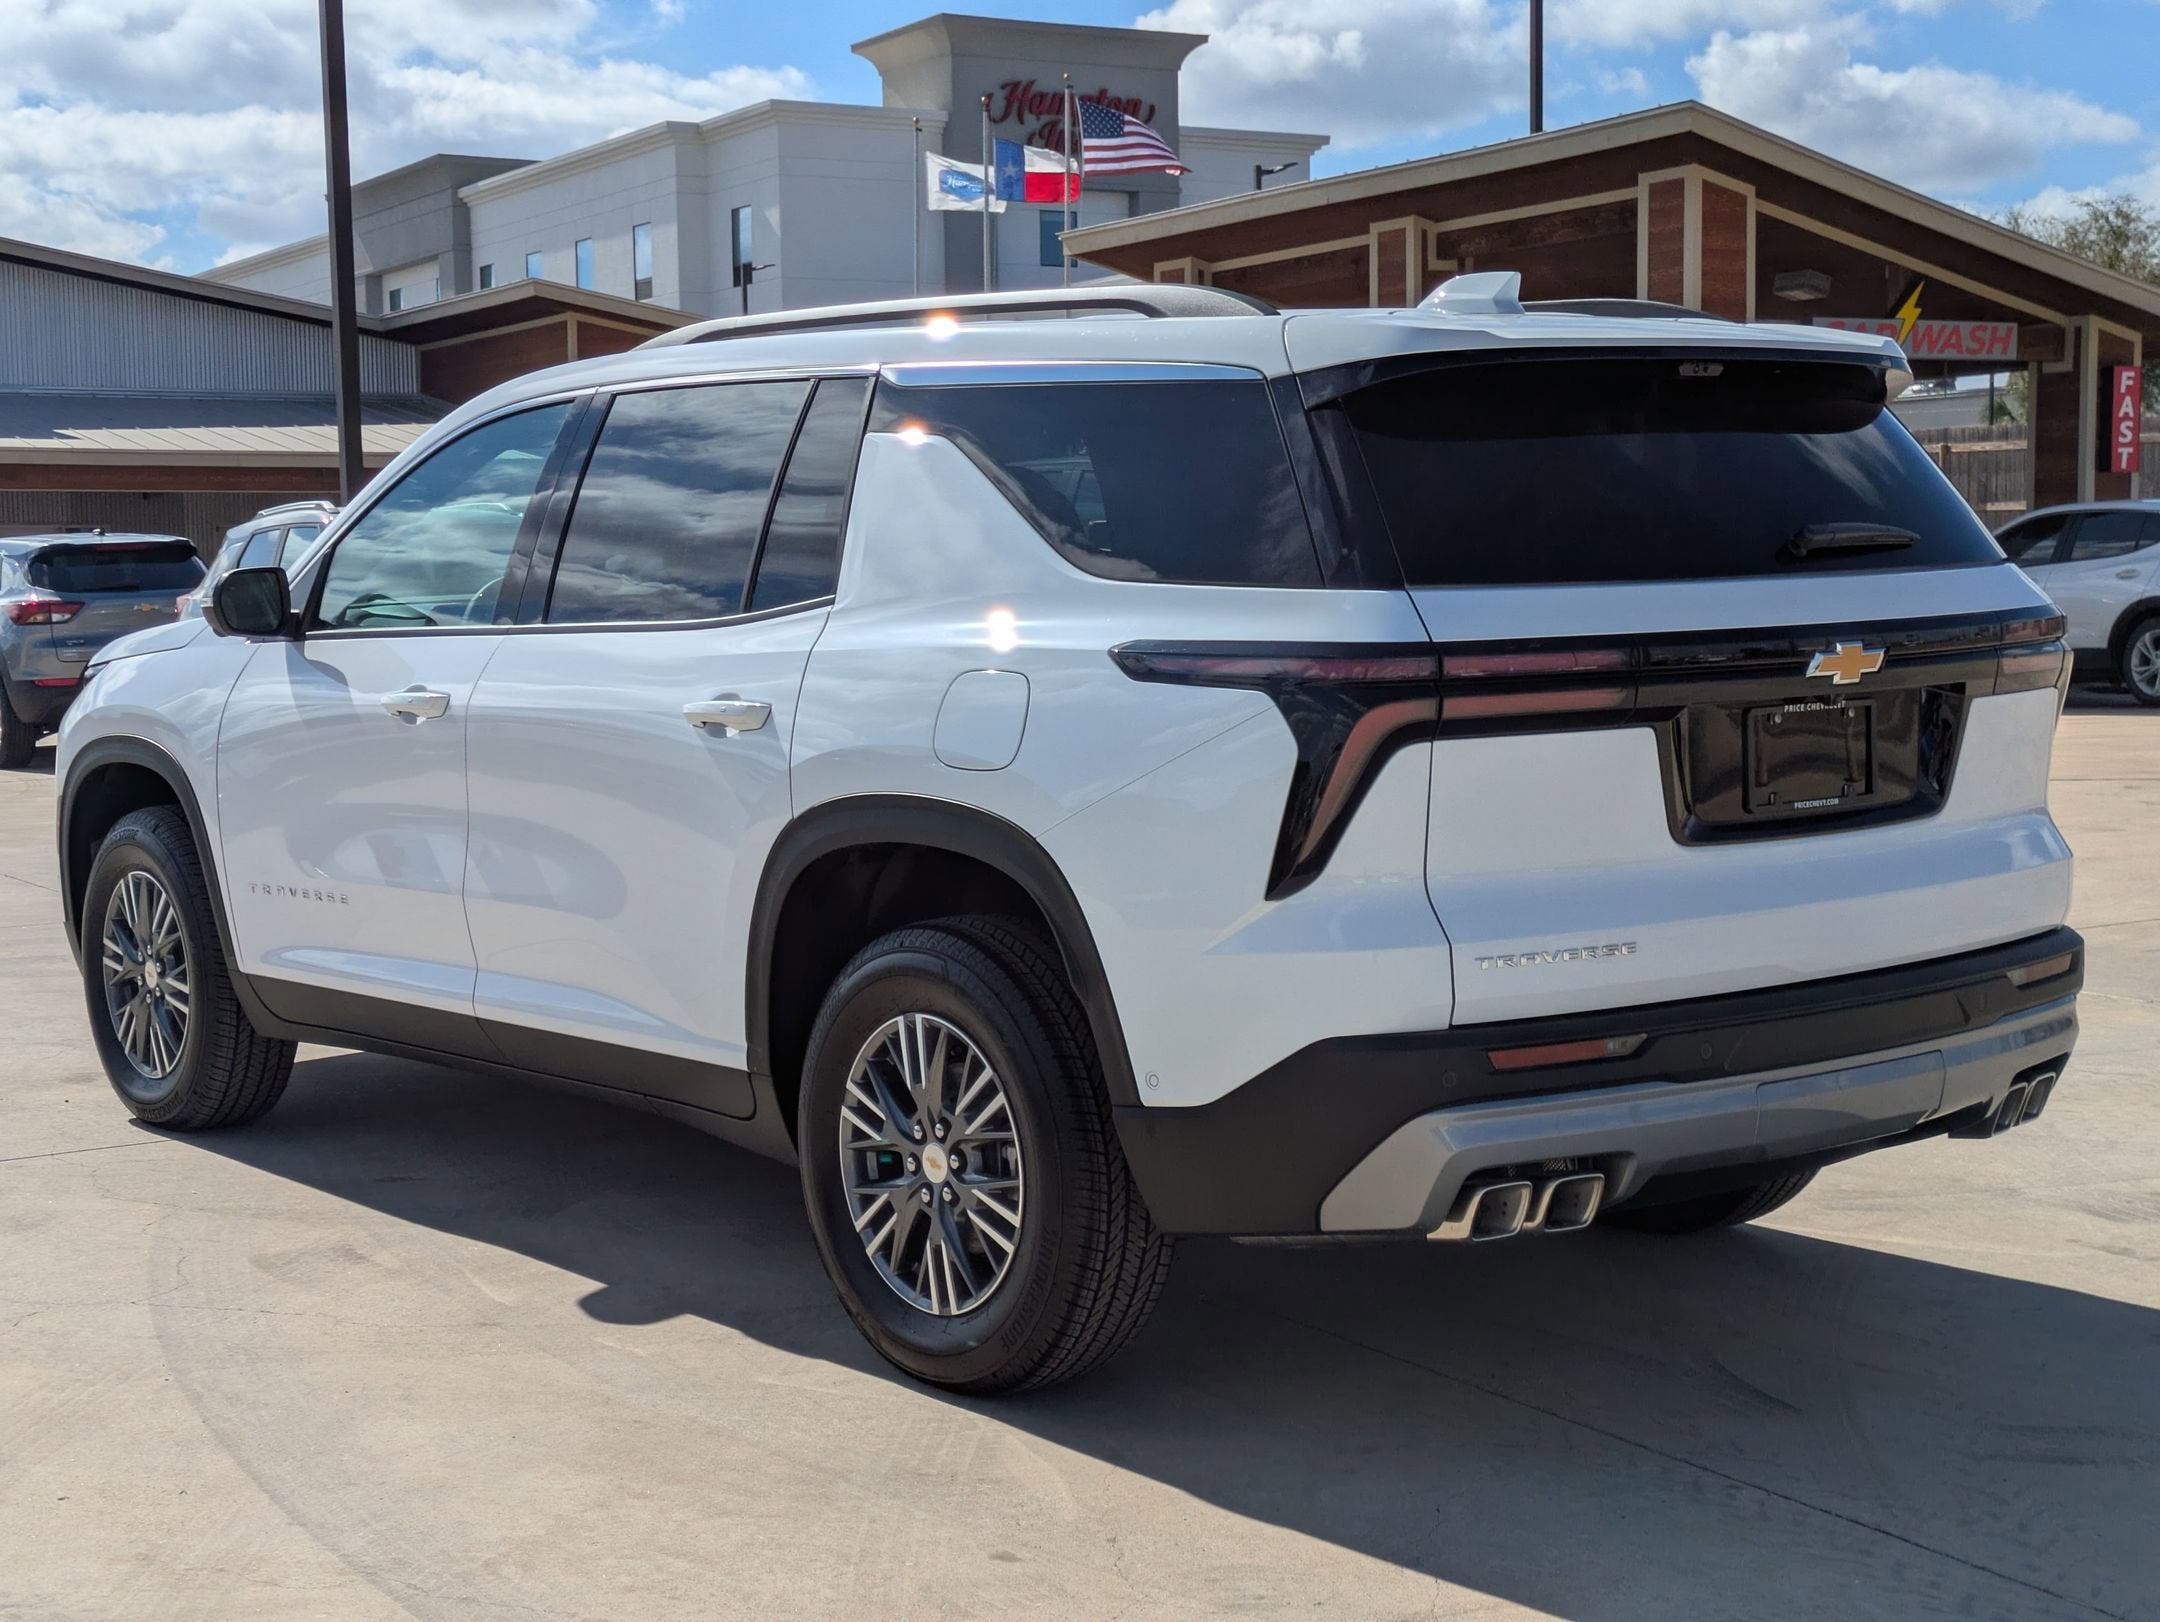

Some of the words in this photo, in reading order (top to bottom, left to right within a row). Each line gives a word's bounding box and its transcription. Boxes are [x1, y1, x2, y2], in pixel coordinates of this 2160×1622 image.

[1911, 322, 2014, 356] WASH
[2117, 370, 2135, 471] FAST
[1784, 703, 1805, 713] PRICE
[248, 883, 350, 905] TRAVERSE
[1474, 941, 1637, 970] TRAVERSE
